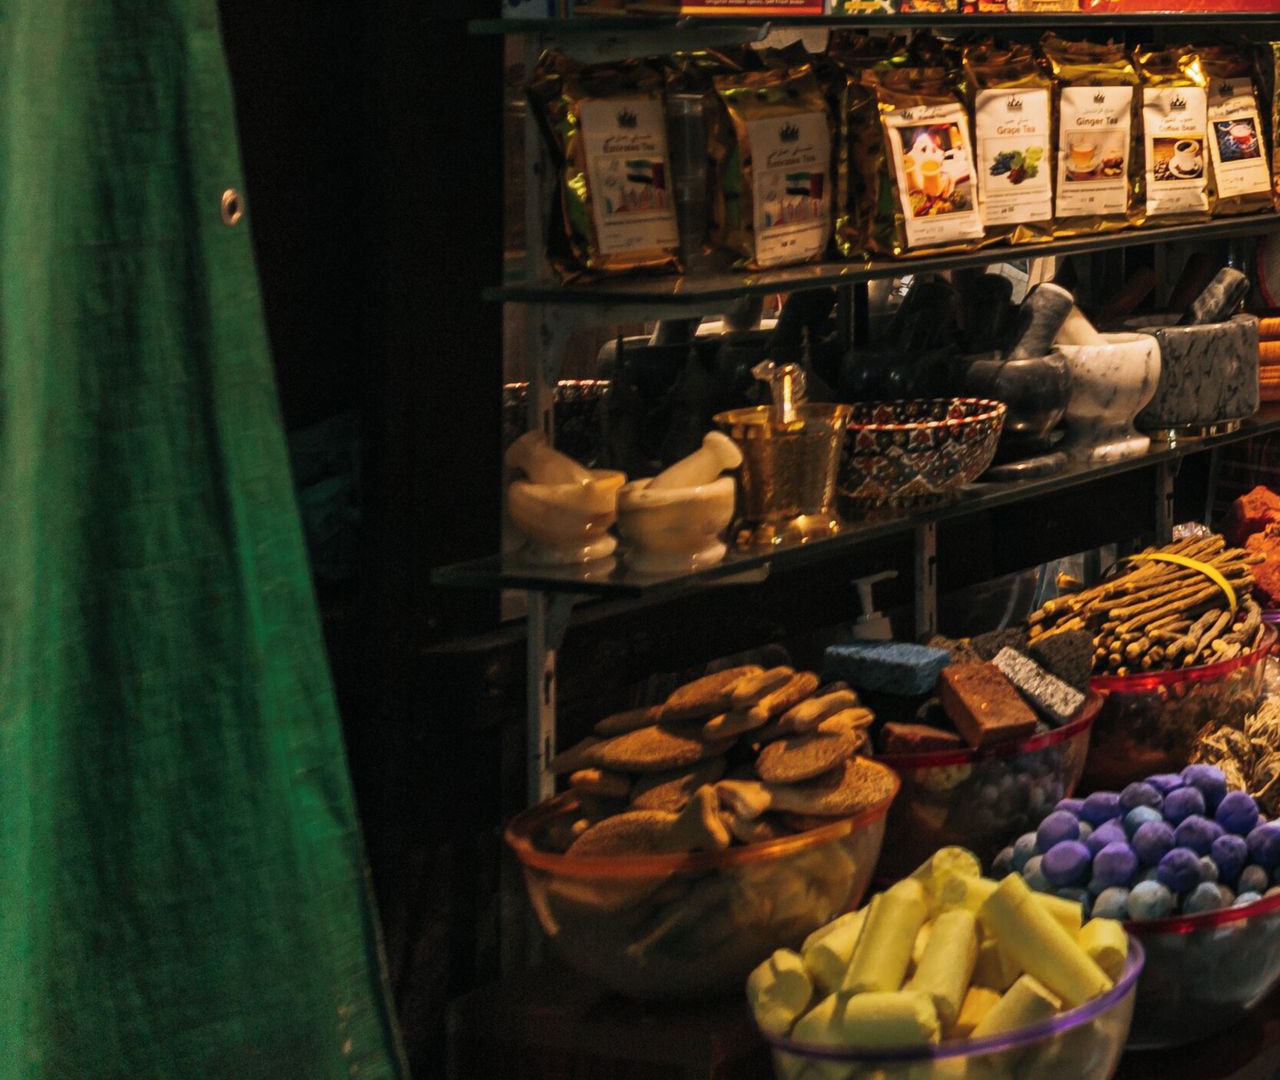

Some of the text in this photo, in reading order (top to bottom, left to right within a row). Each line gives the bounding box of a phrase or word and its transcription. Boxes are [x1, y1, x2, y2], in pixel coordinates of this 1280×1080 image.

[1076, 117, 1118, 126] Ginger Tea
[997, 125, 1036, 135] Grape Tea
